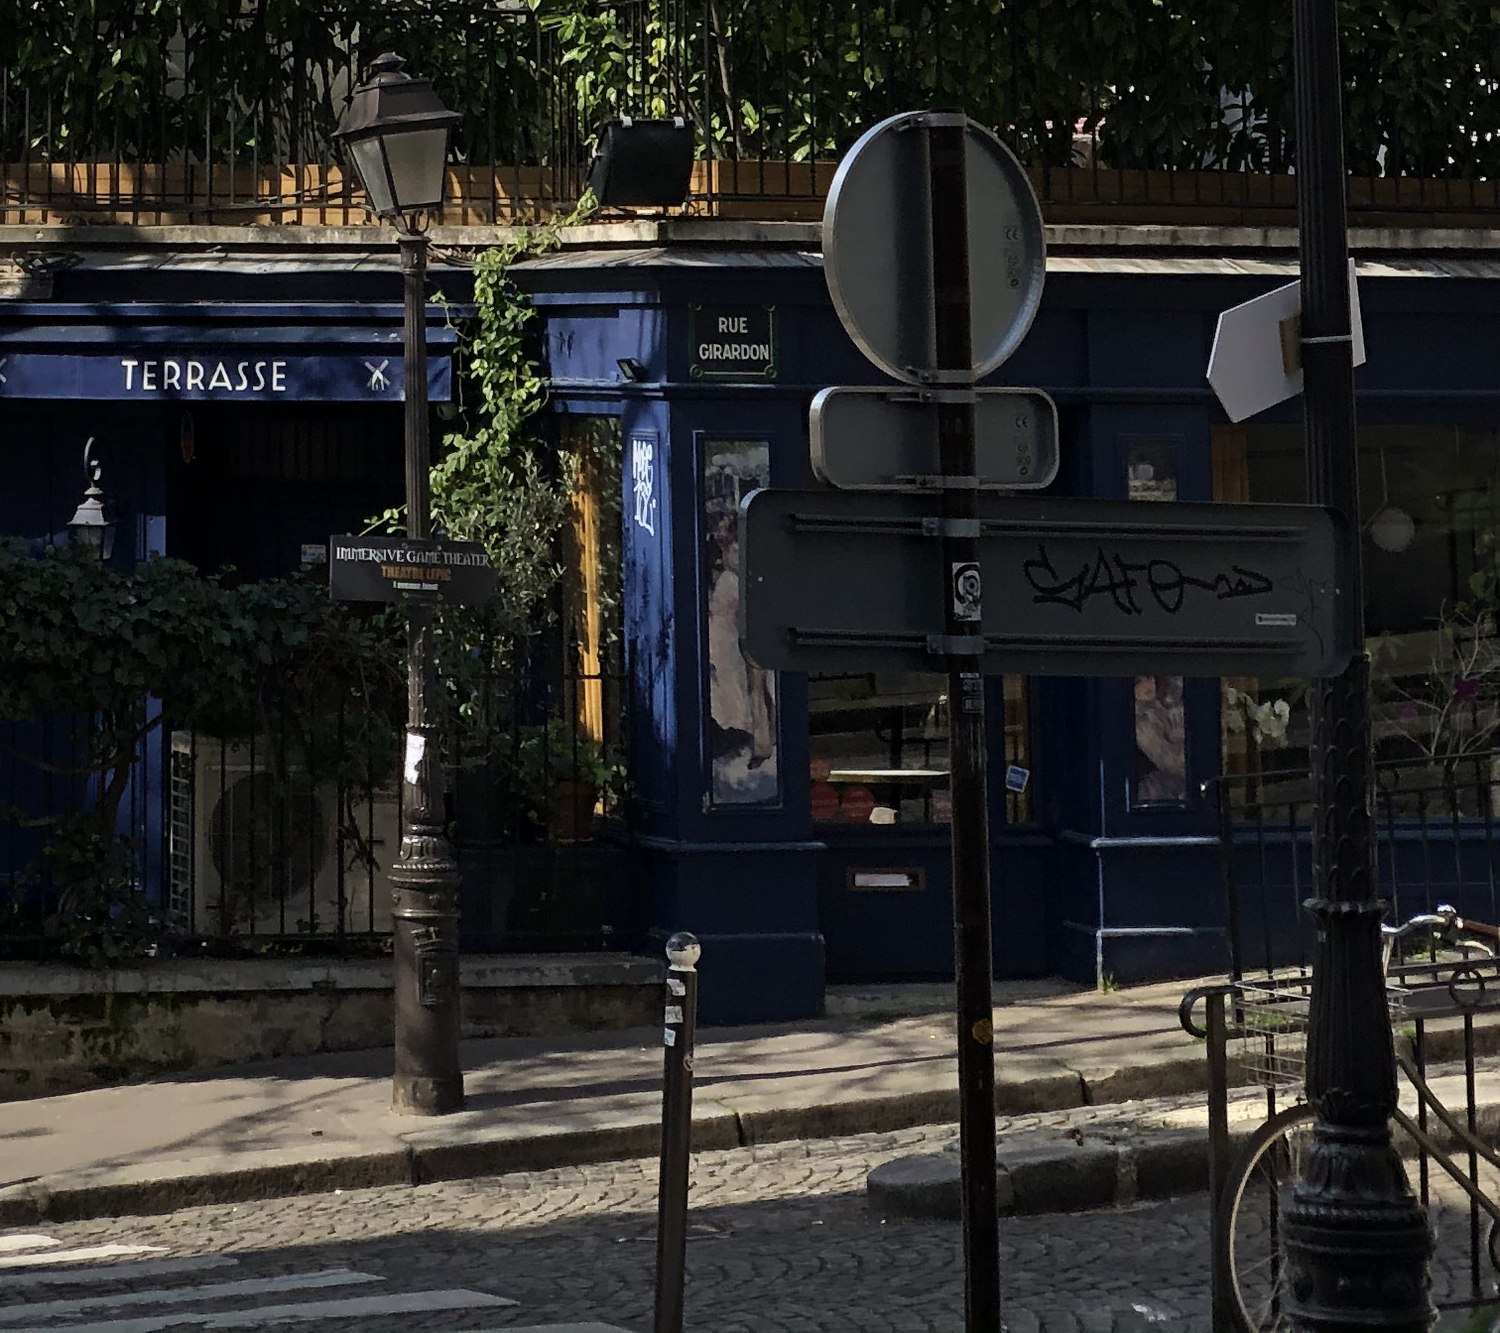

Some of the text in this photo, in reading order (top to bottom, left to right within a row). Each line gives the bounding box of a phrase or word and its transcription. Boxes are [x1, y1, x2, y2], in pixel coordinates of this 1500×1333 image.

[718, 316, 749, 334] RUE
[698, 343, 770, 361] GIRARDON
[121, 359, 287, 392] TERRASSE
[335, 546, 492, 569] IMMERSIVE GAME THEATER
